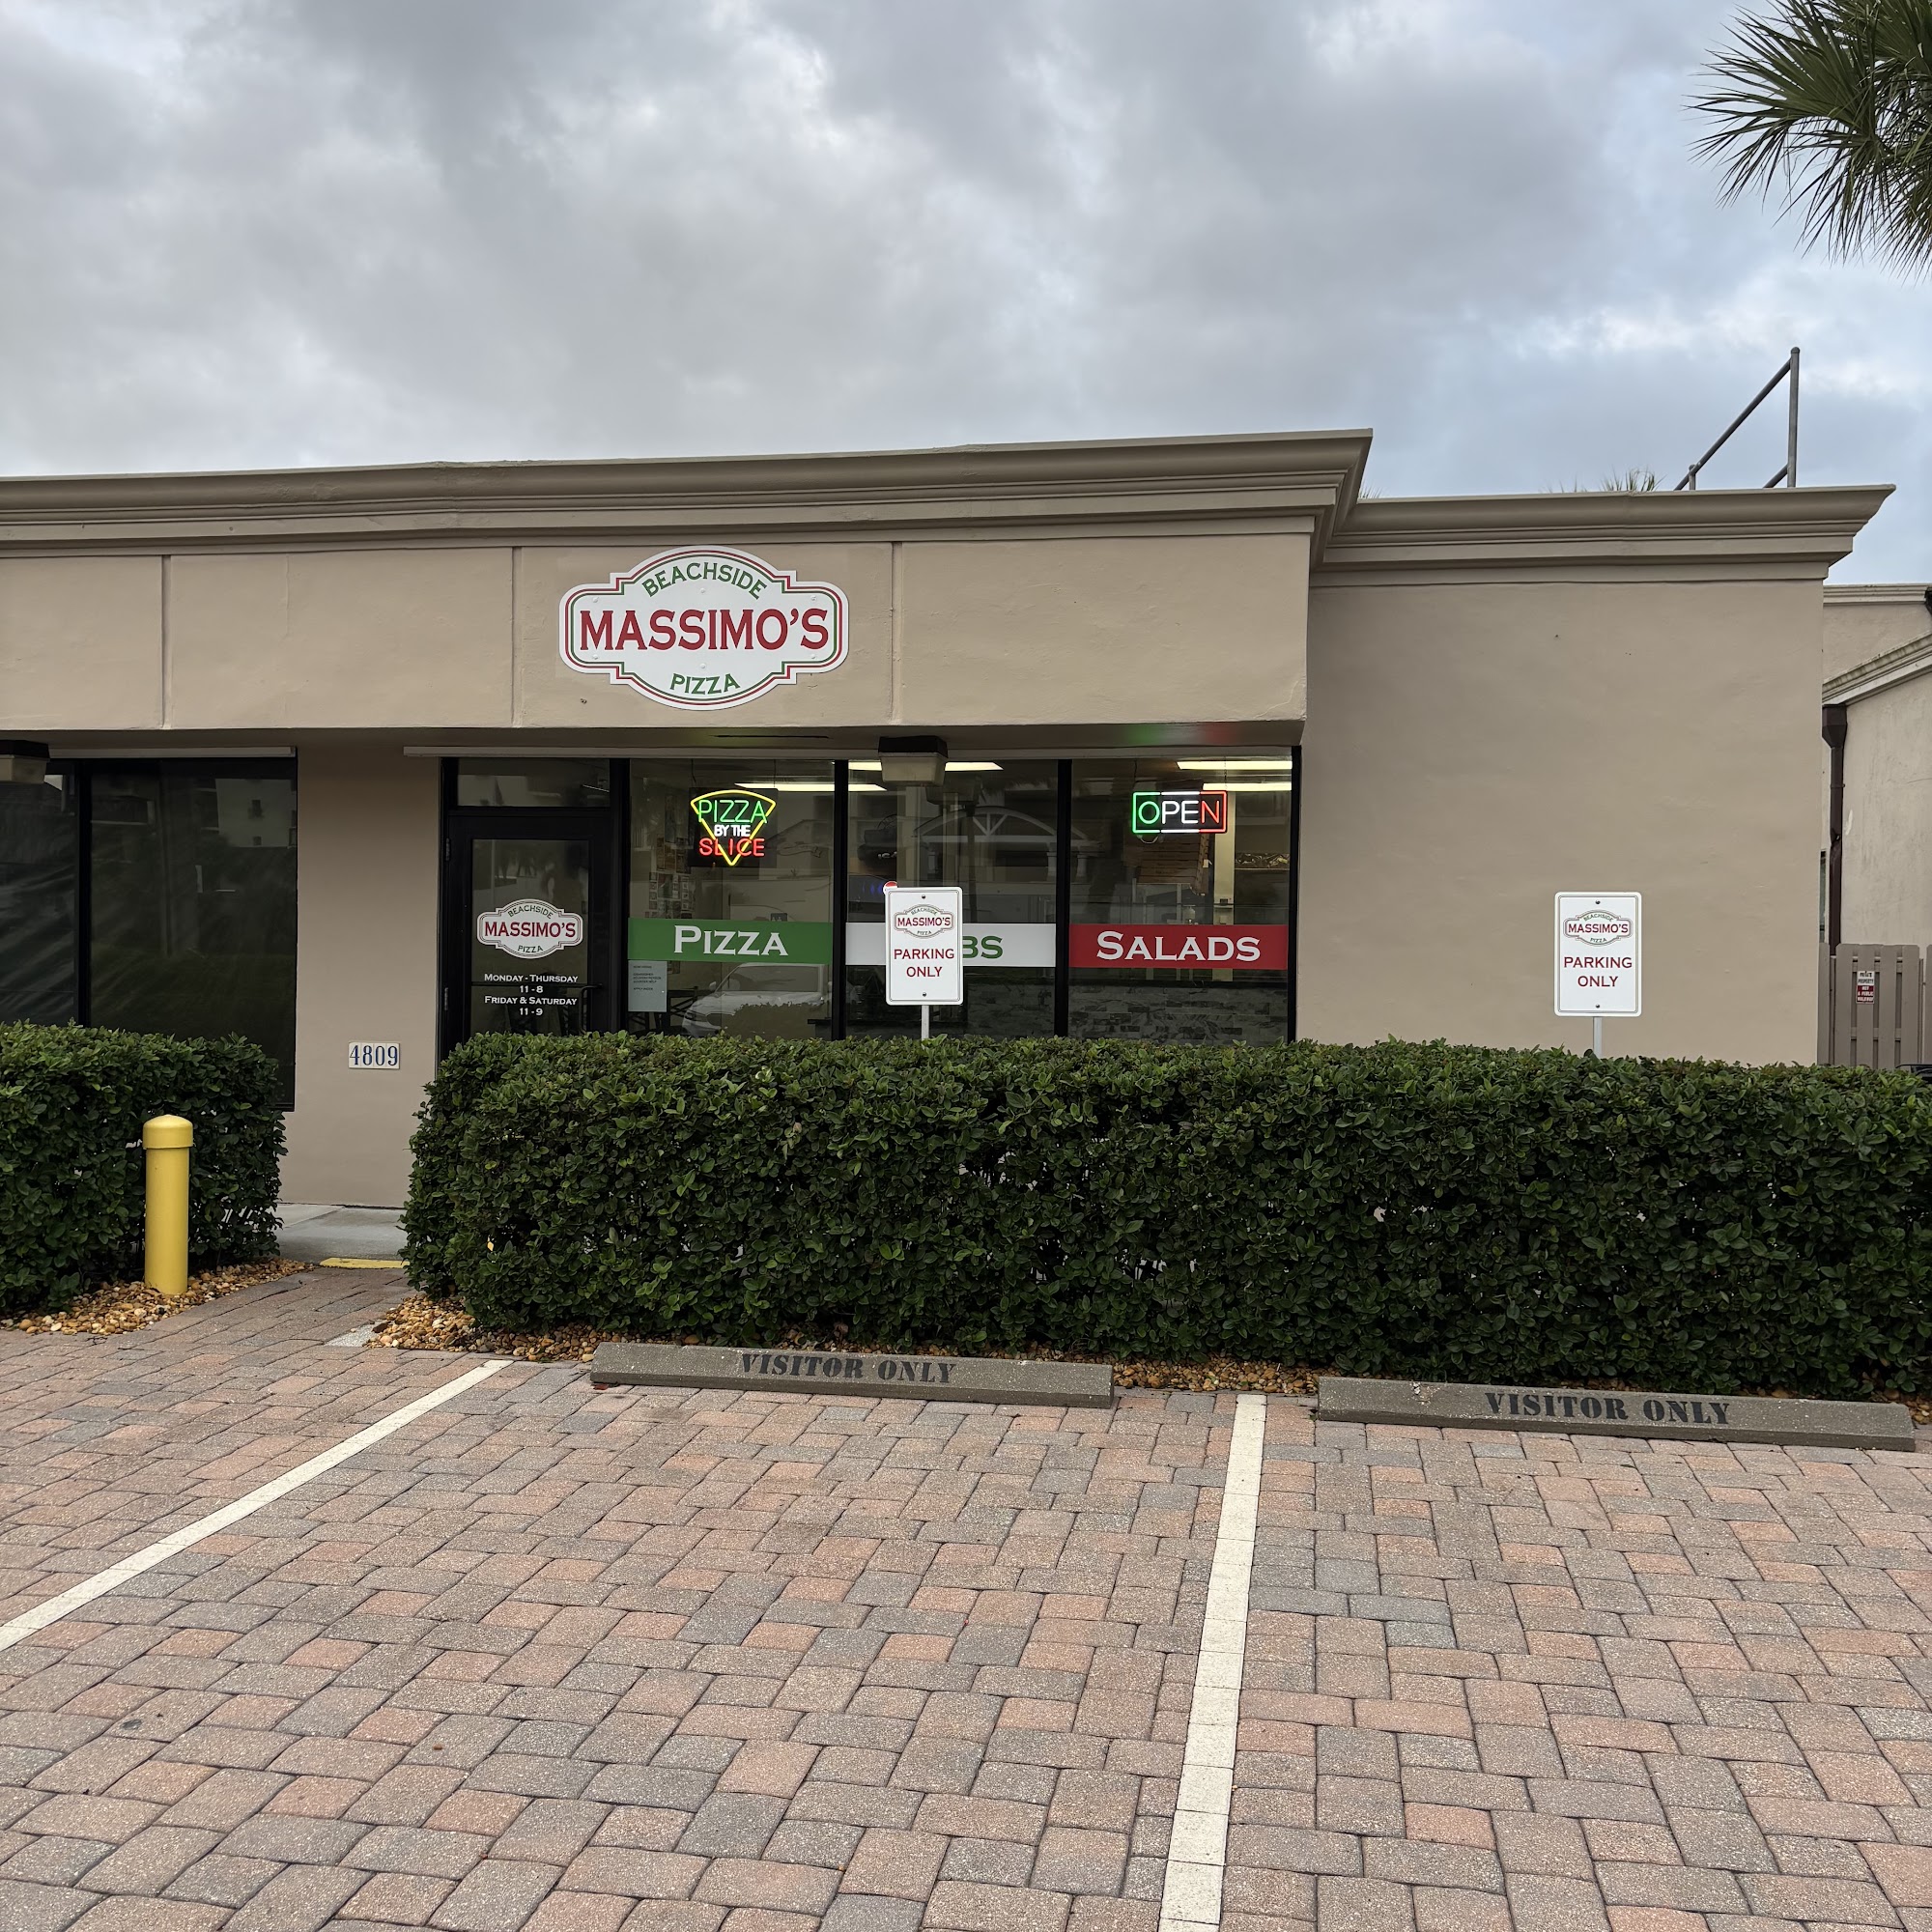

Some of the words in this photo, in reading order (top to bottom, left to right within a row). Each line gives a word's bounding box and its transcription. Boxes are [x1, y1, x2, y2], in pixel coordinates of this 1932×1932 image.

[640, 562, 767, 600] BEACHSIDE
[580, 609, 829, 650] MASSIMO'S
[669, 672, 741, 695] PIZZA
[698, 799, 767, 823] PIZZA
[1138, 800, 1220, 825] OPEN
[714, 824, 729, 837] BY
[731, 824, 751, 837] THE
[698, 838, 765, 856] SLICE
[507, 905, 554, 919] BEACHSIDE
[897, 917, 951, 926] MASSIMO'S
[1568, 923, 1629, 933] MASSIMO'S
[484, 922, 576, 937] MASSIMO'S
[894, 949, 954, 959] PARKING
[1563, 956, 1633, 968] PARKING
[906, 966, 943, 978] ONLY
[1577, 976, 1619, 987] ONLY
[520, 996, 527, 1005] &
[536, 1008, 543, 1016] 9
[350, 1045, 398, 1065] 4809
[742, 1353, 864, 1379] VISITOR
[877, 1359, 956, 1383] ONLY
[1484, 1392, 1629, 1420] VISITOR
[1643, 1400, 1730, 1425] ONLY
